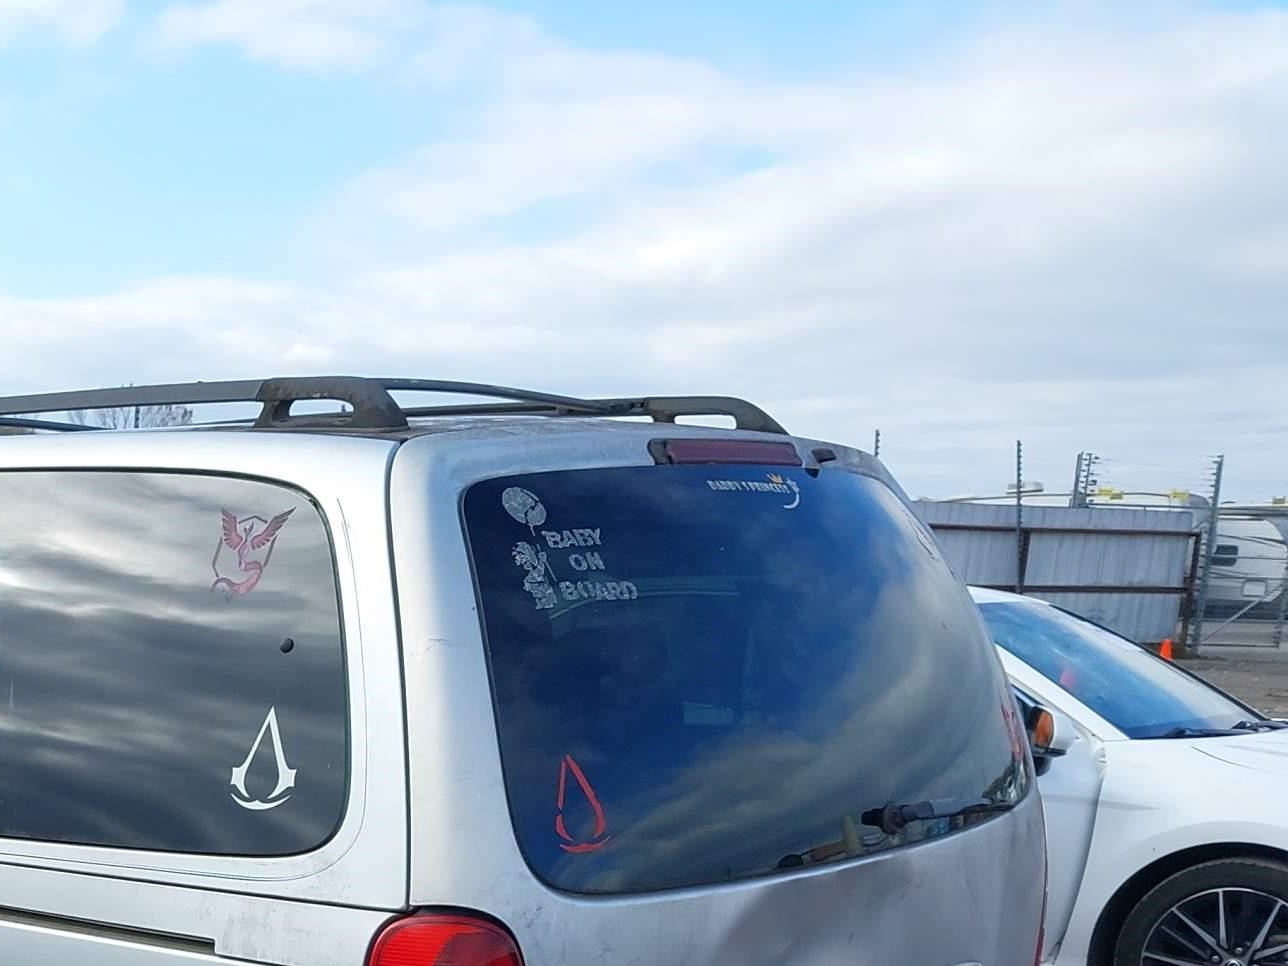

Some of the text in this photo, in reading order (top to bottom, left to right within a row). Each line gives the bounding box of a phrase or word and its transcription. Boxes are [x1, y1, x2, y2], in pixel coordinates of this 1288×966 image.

[541, 527, 602, 549] BABY
[568, 551, 605, 571] ON
[559, 580, 638, 601] BOARD
